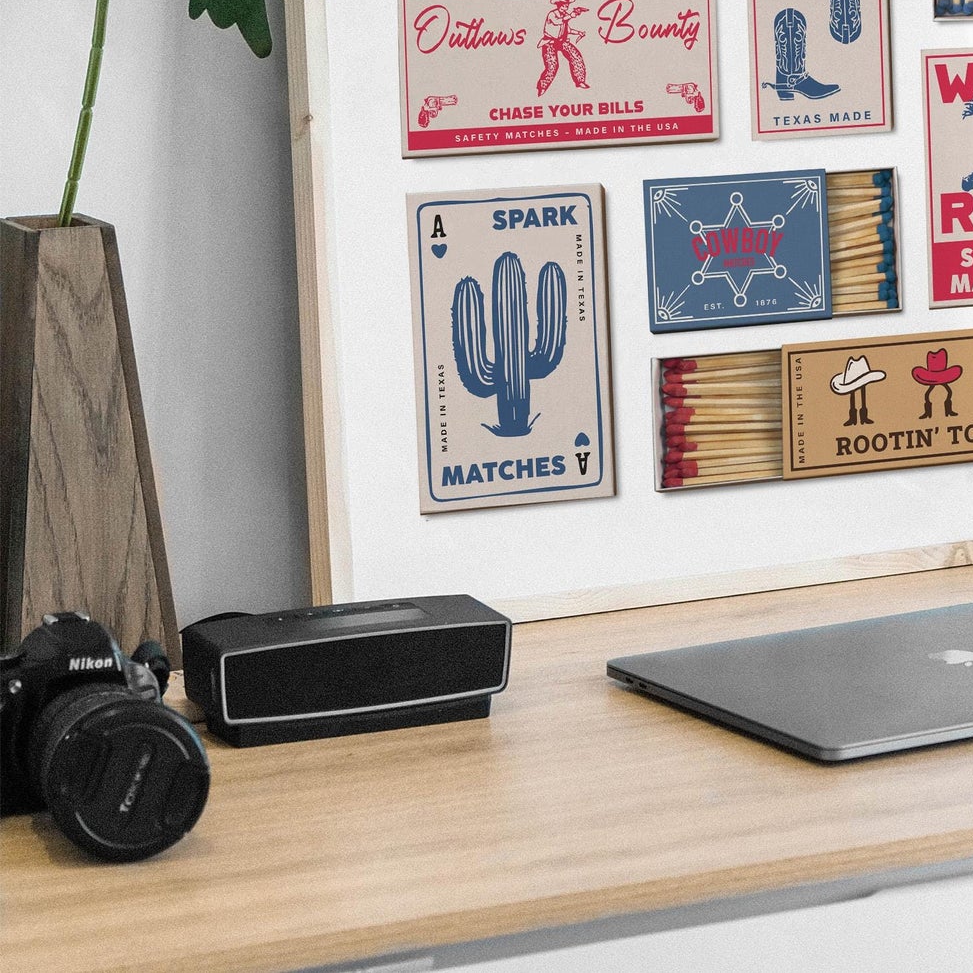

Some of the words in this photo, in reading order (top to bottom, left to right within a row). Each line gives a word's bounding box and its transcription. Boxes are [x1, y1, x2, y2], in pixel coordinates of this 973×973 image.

[414, 4, 526, 54] Outlaws
[489, 107, 543, 121] CHASE
[548, 104, 593, 117] YOUR
[598, 100, 644, 115] BILLS
[774, 114, 821, 126] TEXAS
[830, 111, 872, 123] MADE
[455, 133, 499, 142] SAFETY
[505, 129, 560, 139] MATCHES
[575, 126, 607, 135] MADE
[613, 125, 625, 133] IN
[630, 124, 652, 132] THE
[657, 122, 679, 131] USA
[431, 214, 447, 238] A
[492, 205, 577, 230] SPARK
[691, 227, 784, 262] COWBOY
[577, 270, 584, 282] IN
[438, 364, 446, 399] TEXAS
[440, 404, 446, 417] IN
[797, 413, 804, 425] IN
[441, 455, 566, 487] MATCHES
[575, 452, 591, 475] A
[69, 657, 113, 671] Nikon
